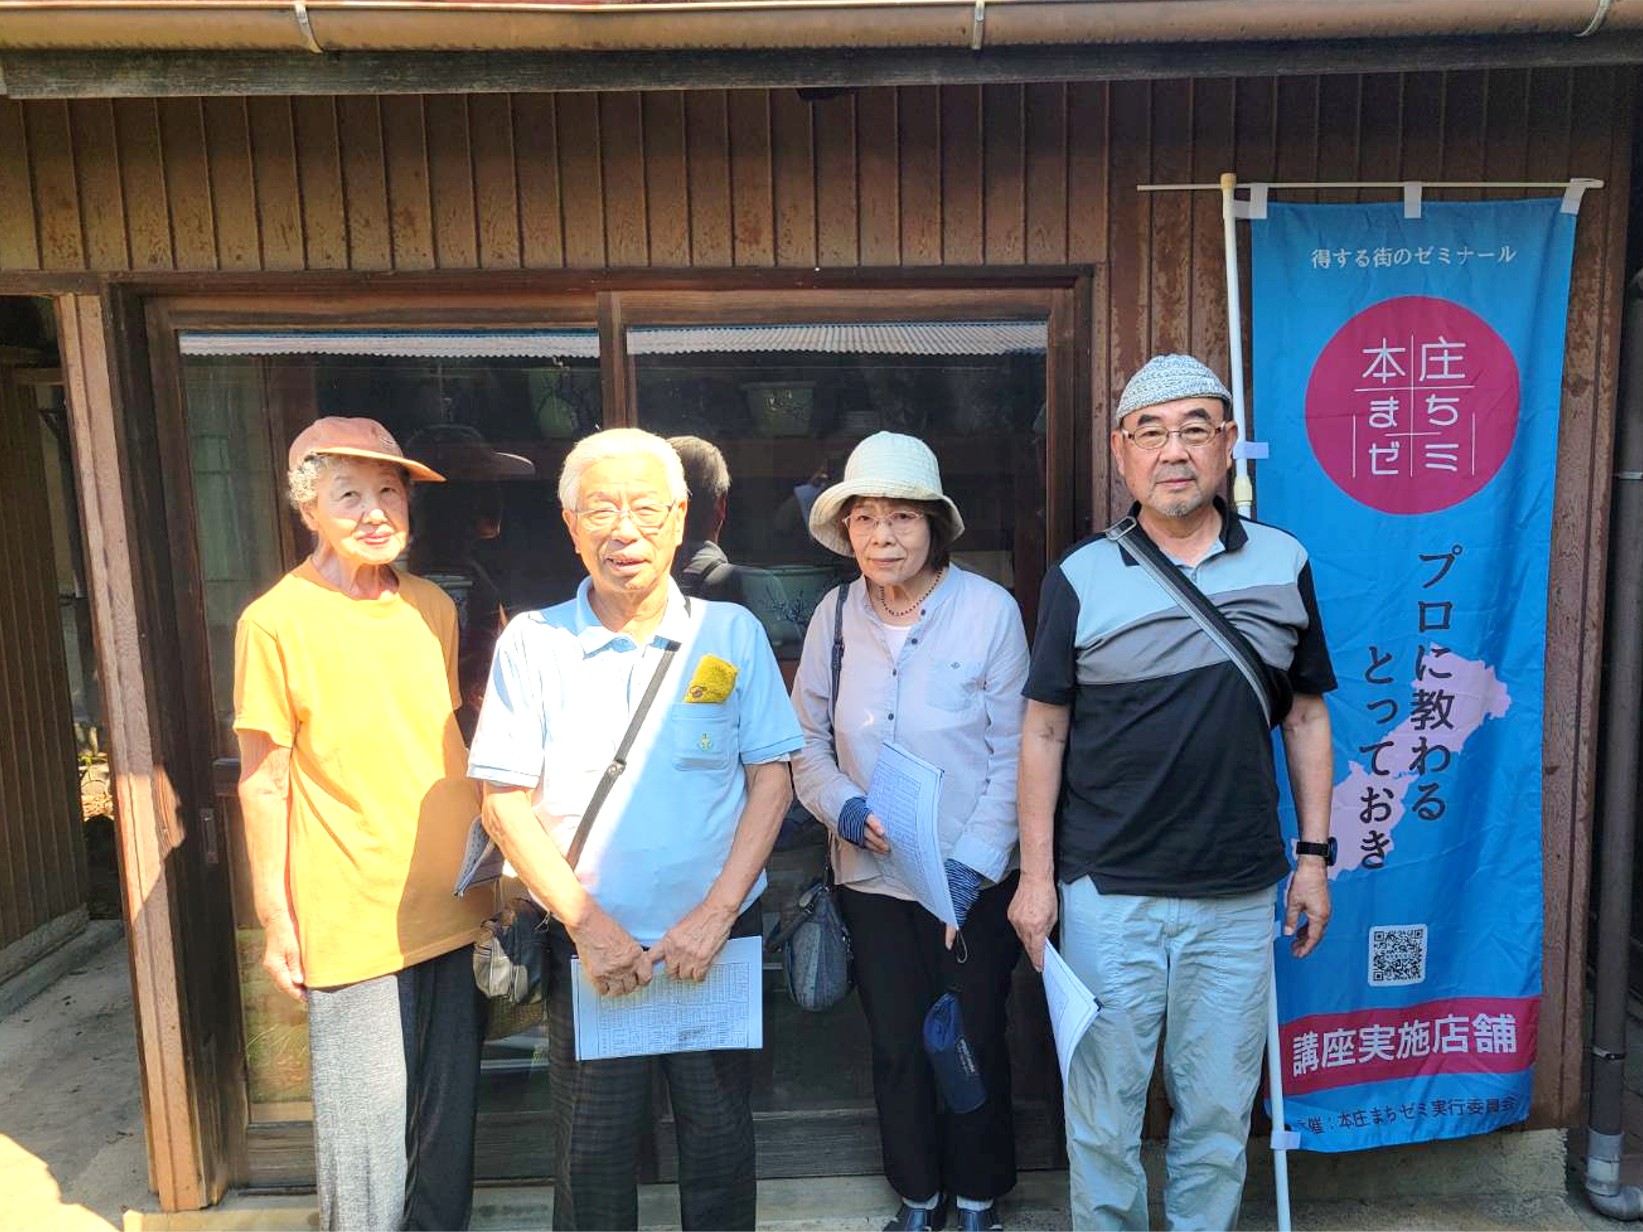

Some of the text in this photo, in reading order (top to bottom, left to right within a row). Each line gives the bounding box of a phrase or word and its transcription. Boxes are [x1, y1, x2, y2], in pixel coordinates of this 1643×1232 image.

[1311, 244, 1517, 269] 得する街のゼミナール
[1362, 336, 1467, 384] 本庄
[1368, 393, 1460, 429] まち
[1368, 441, 1460, 476] ゼミ
[1409, 544, 1463, 821] プロに教わる
[1359, 646, 1398, 869] とっておき
[1292, 1013, 1518, 1077] 講座実施店舗
